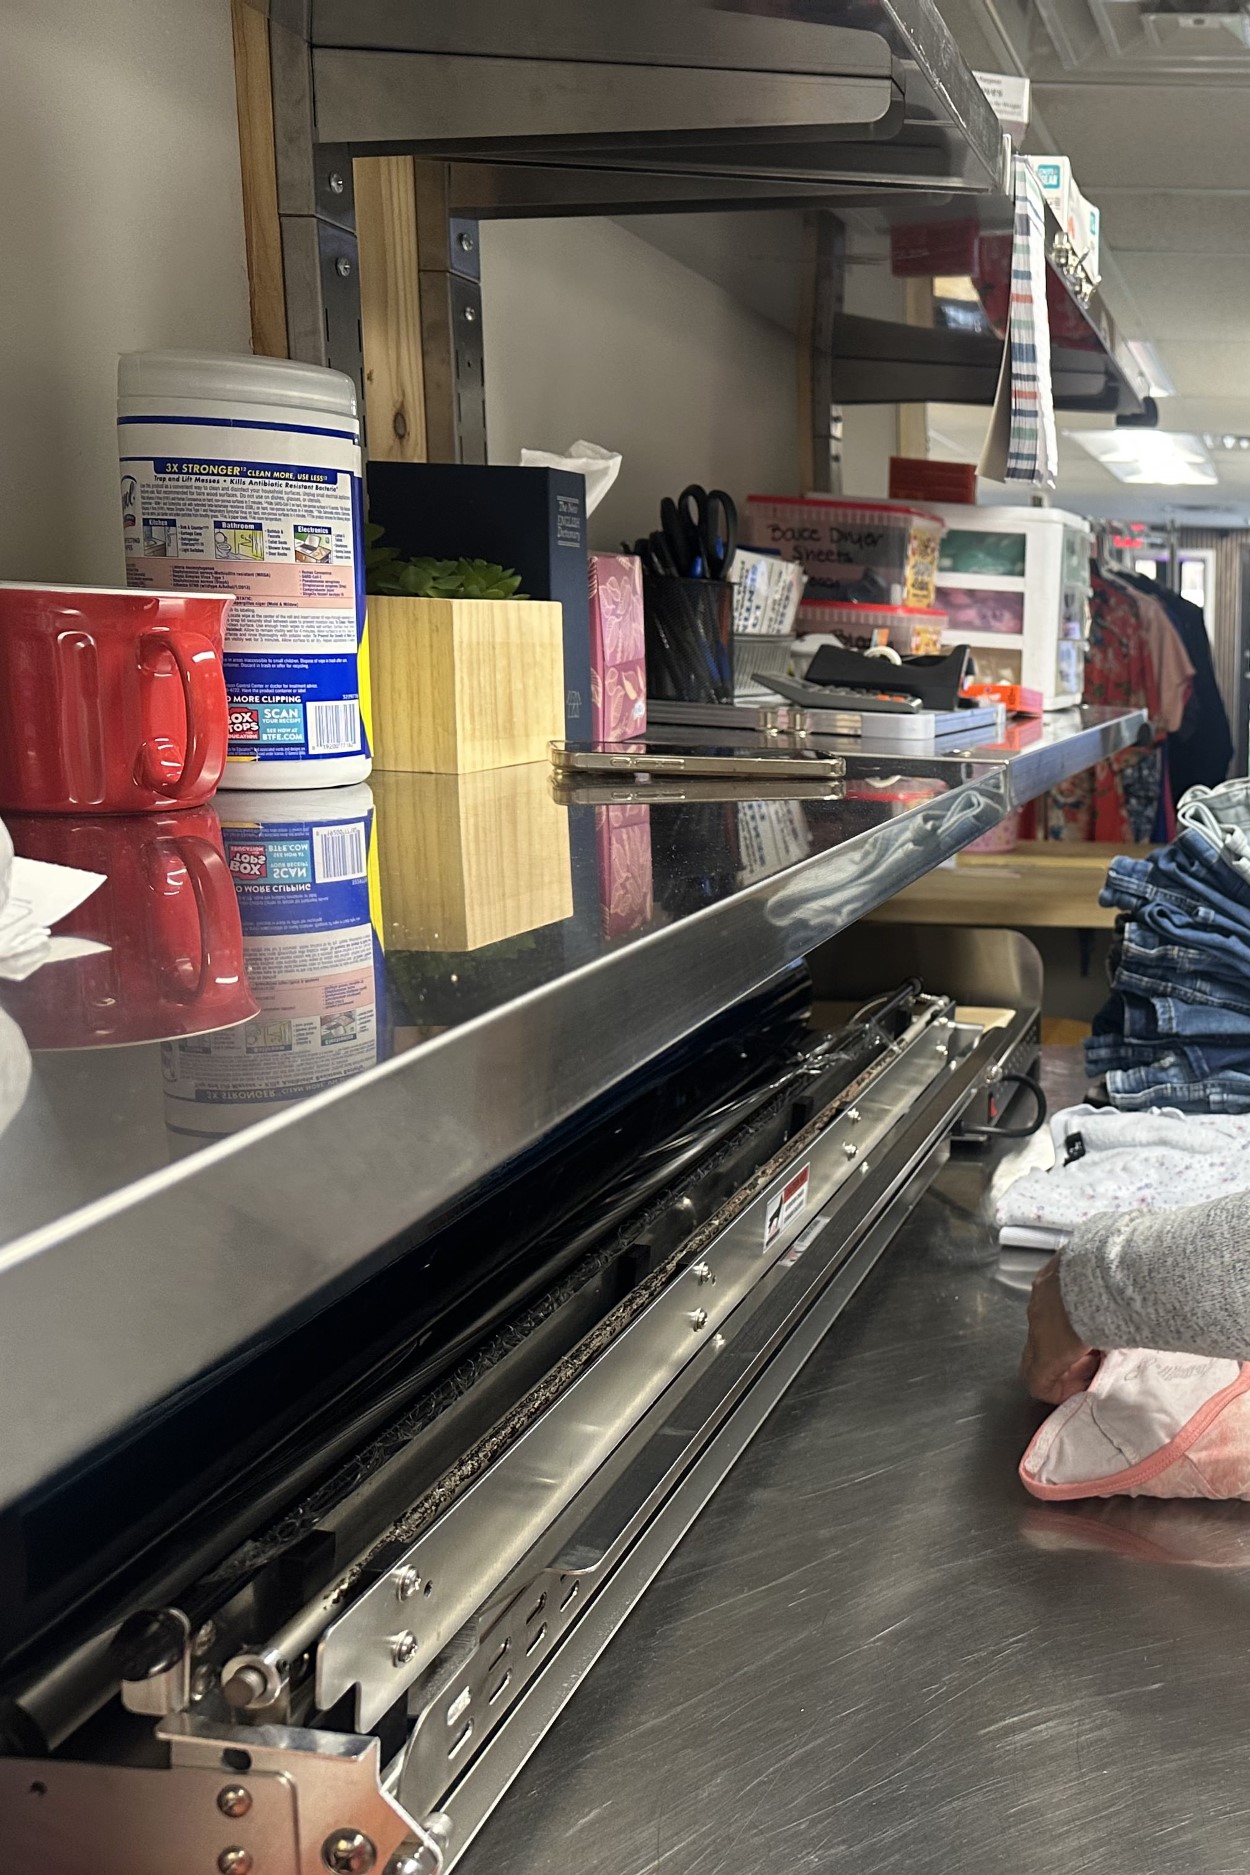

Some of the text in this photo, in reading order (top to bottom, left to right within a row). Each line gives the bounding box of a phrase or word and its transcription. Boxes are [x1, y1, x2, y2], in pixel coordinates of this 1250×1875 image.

[166, 464, 178, 472] 3X
[272, 472, 296, 480] MORE,
[154, 475, 166, 483] Trap
[248, 479, 282, 488] Antibiotic
[285, 482, 314, 490] Resistant
[298, 525, 328, 534] Electronics
[228, 712, 253, 724] OX
[264, 708, 298, 718] SCAN
